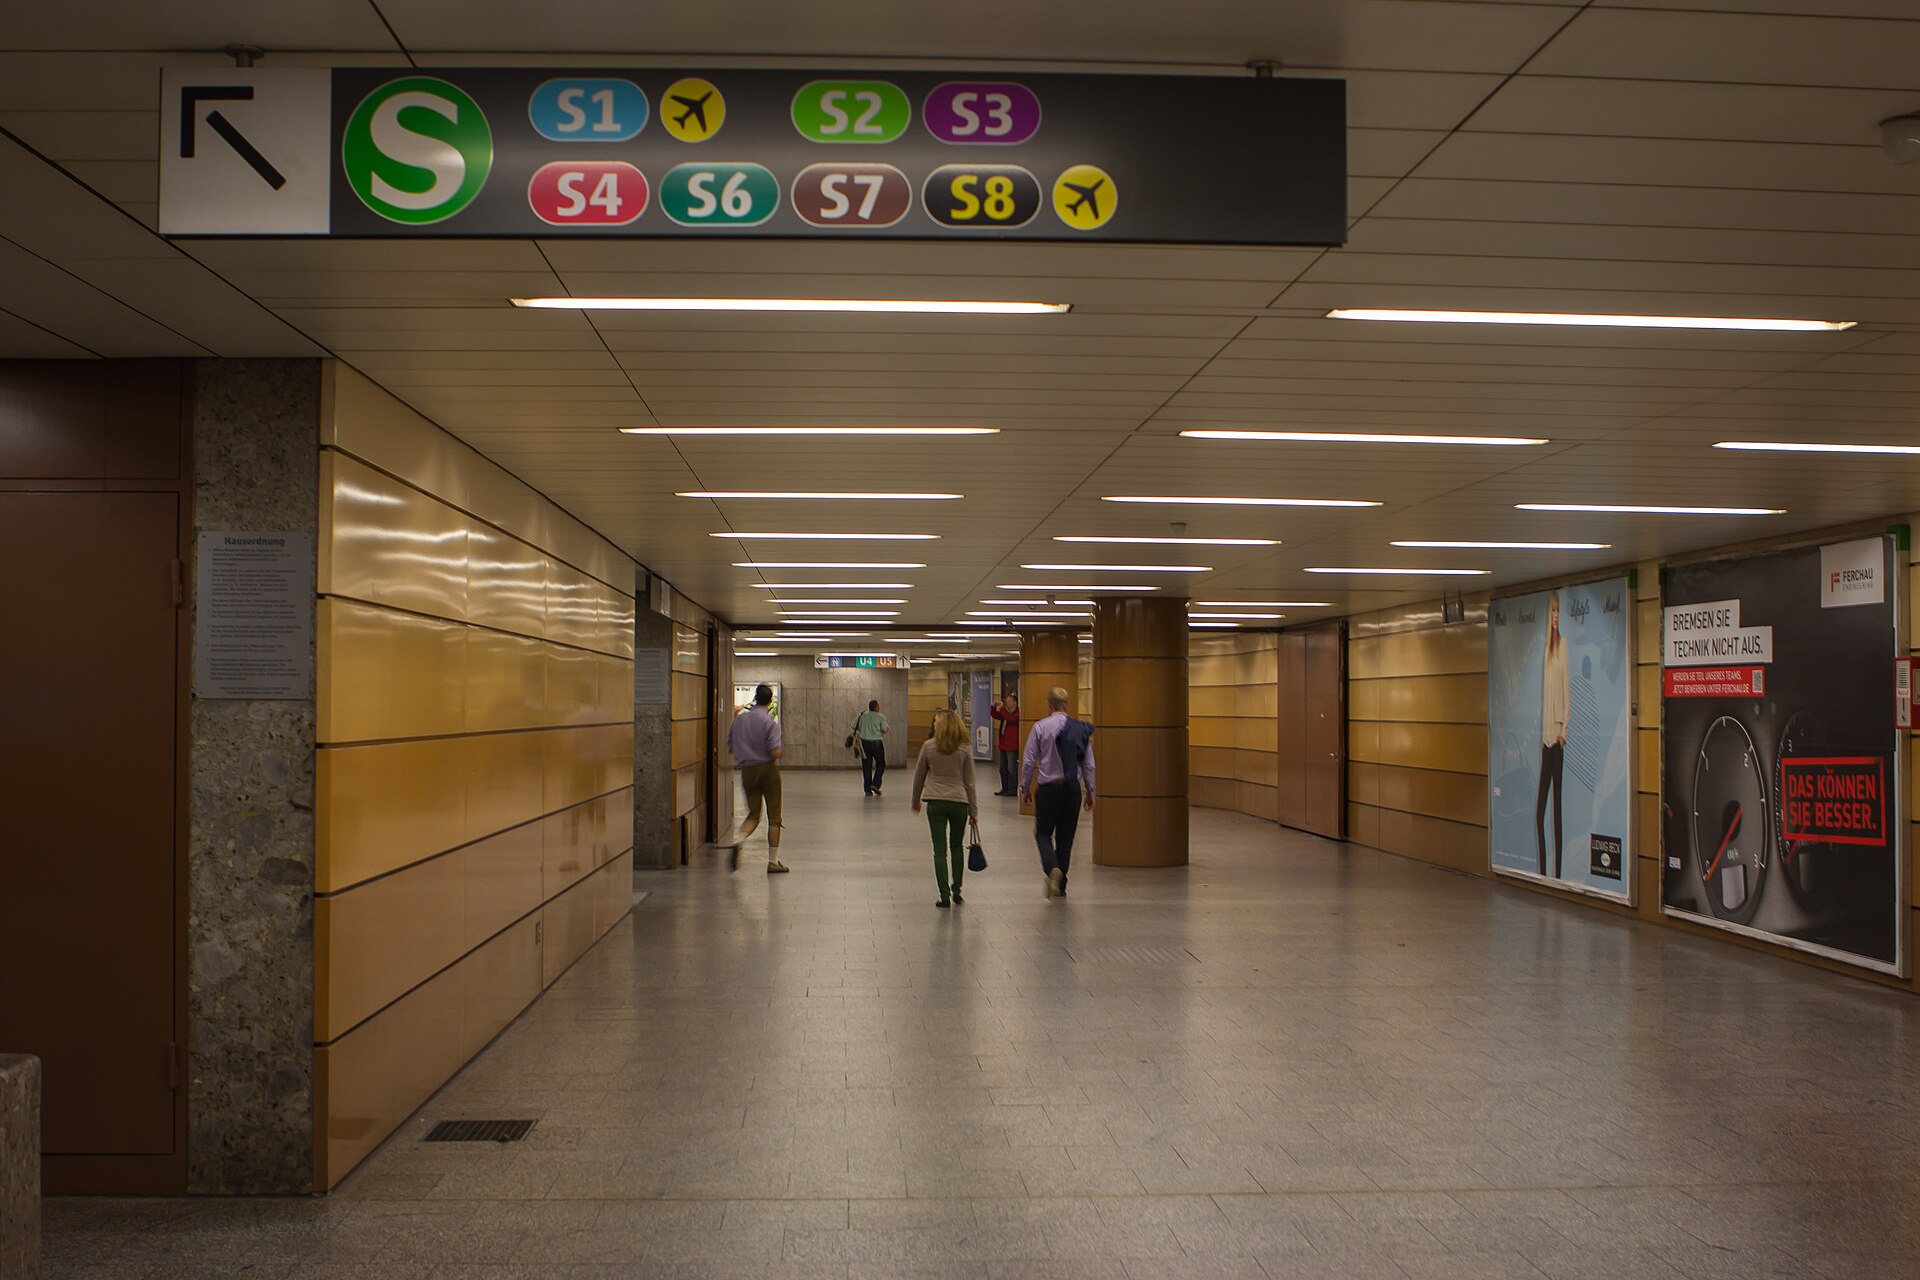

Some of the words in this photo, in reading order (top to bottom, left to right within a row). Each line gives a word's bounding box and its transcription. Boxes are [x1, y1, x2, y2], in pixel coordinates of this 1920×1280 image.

[557, 88, 622, 133] S1
[819, 90, 884, 136] S2
[951, 91, 1014, 136] S3
[369, 90, 467, 210] S
[557, 171, 623, 217] S4
[687, 171, 753, 218] S6
[819, 174, 885, 220] S7
[950, 174, 1016, 221] S8
[224, 536, 285, 547] Hausordnung
[1842, 568, 1873, 582] FERCHAU
[1673, 610, 1714, 631] BREMSEN
[1715, 608, 1731, 627] SIE
[1673, 638, 1710, 658] TECHNIK
[1711, 636, 1740, 656] NICHT
[1741, 635, 1764, 655] AUS.
[859, 657, 873, 666] U4
[879, 657, 893, 666] U5
[1788, 774, 1815, 799] DAS
[1817, 768, 1877, 800] KÖNNEN
[1789, 800, 1812, 827] SIE
[1815, 801, 1878, 831] BESSER.
